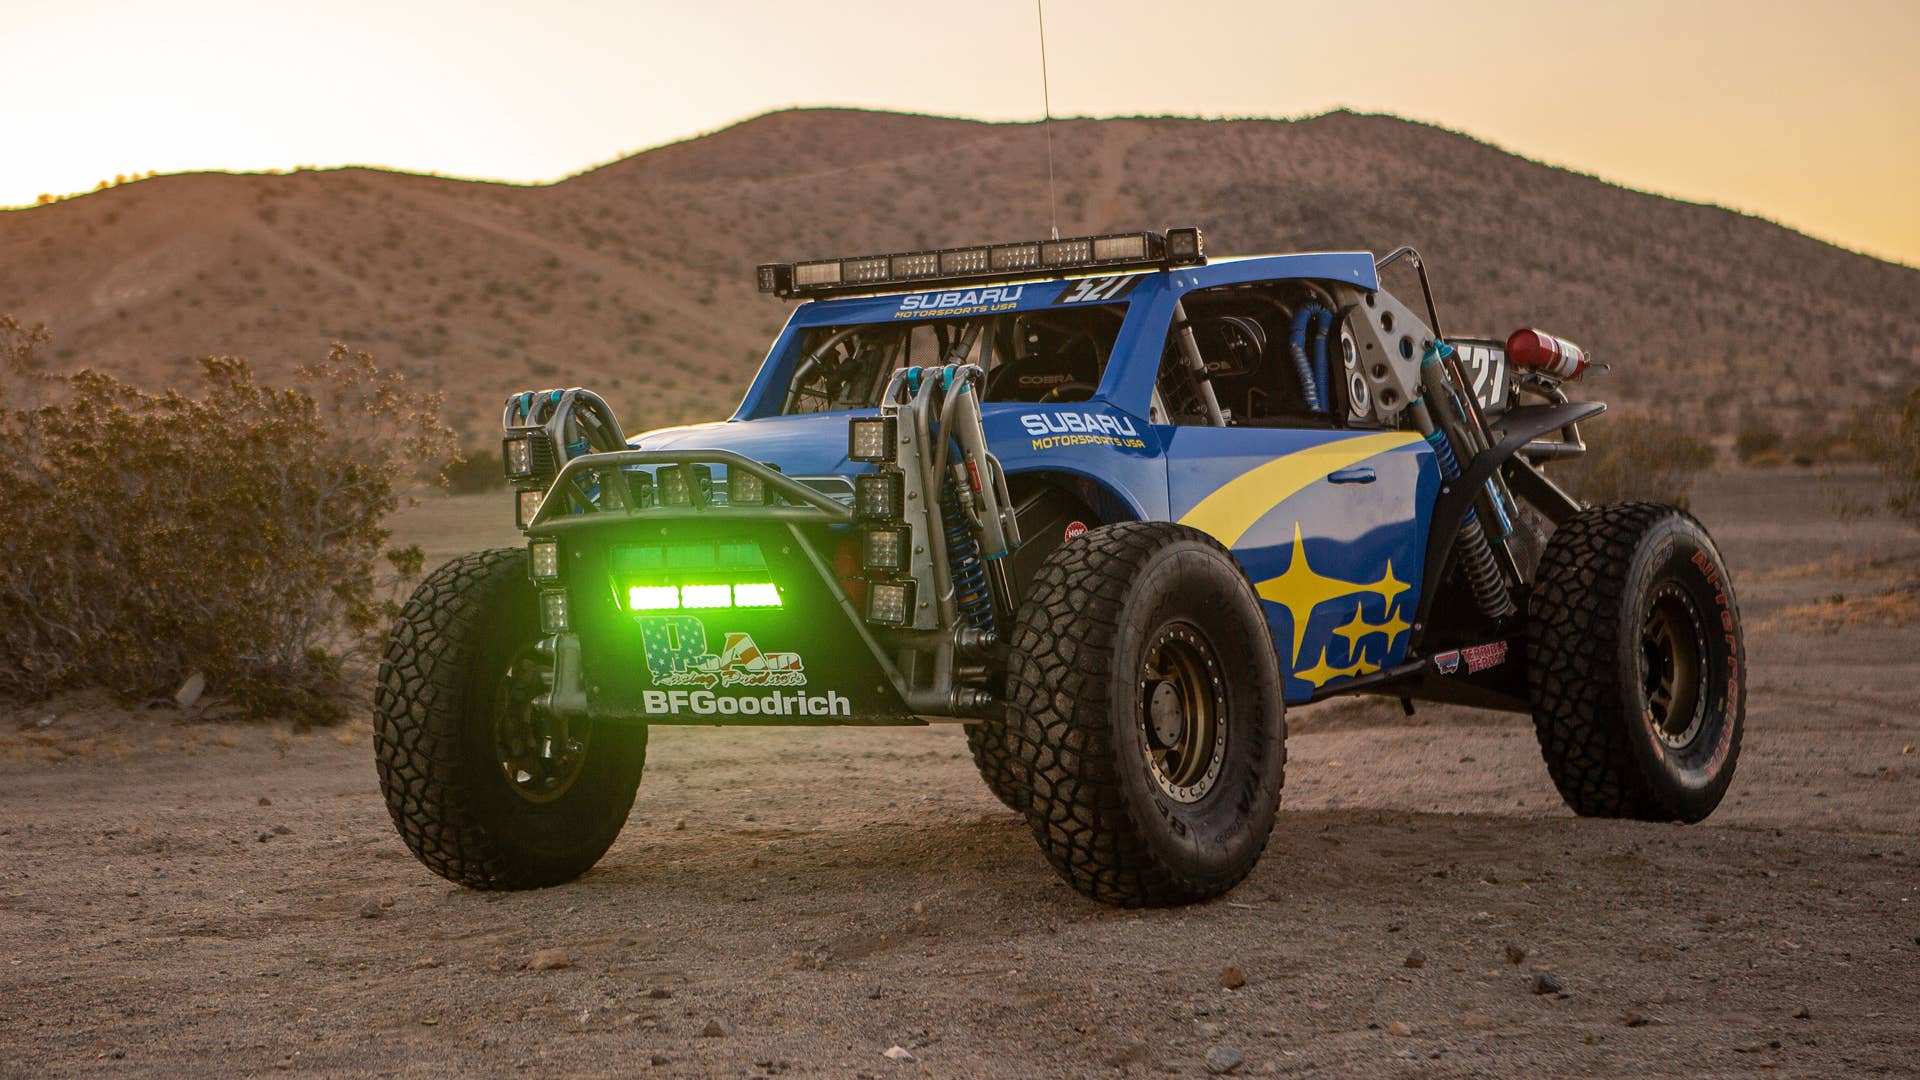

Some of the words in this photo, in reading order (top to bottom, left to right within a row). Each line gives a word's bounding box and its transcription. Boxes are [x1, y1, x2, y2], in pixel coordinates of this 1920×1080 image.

[899, 286, 1024, 310] SUBARU
[894, 305, 987, 319] MOTORSPORTS
[990, 302, 1018, 312] USA
[1019, 373, 1075, 385] COBRA
[1020, 412, 1138, 437] SUBARU
[1032, 435, 1122, 450] MOTORSPORTS
[1122, 438, 1146, 449] USA
[642, 690, 851, 716] BFGoodrich
